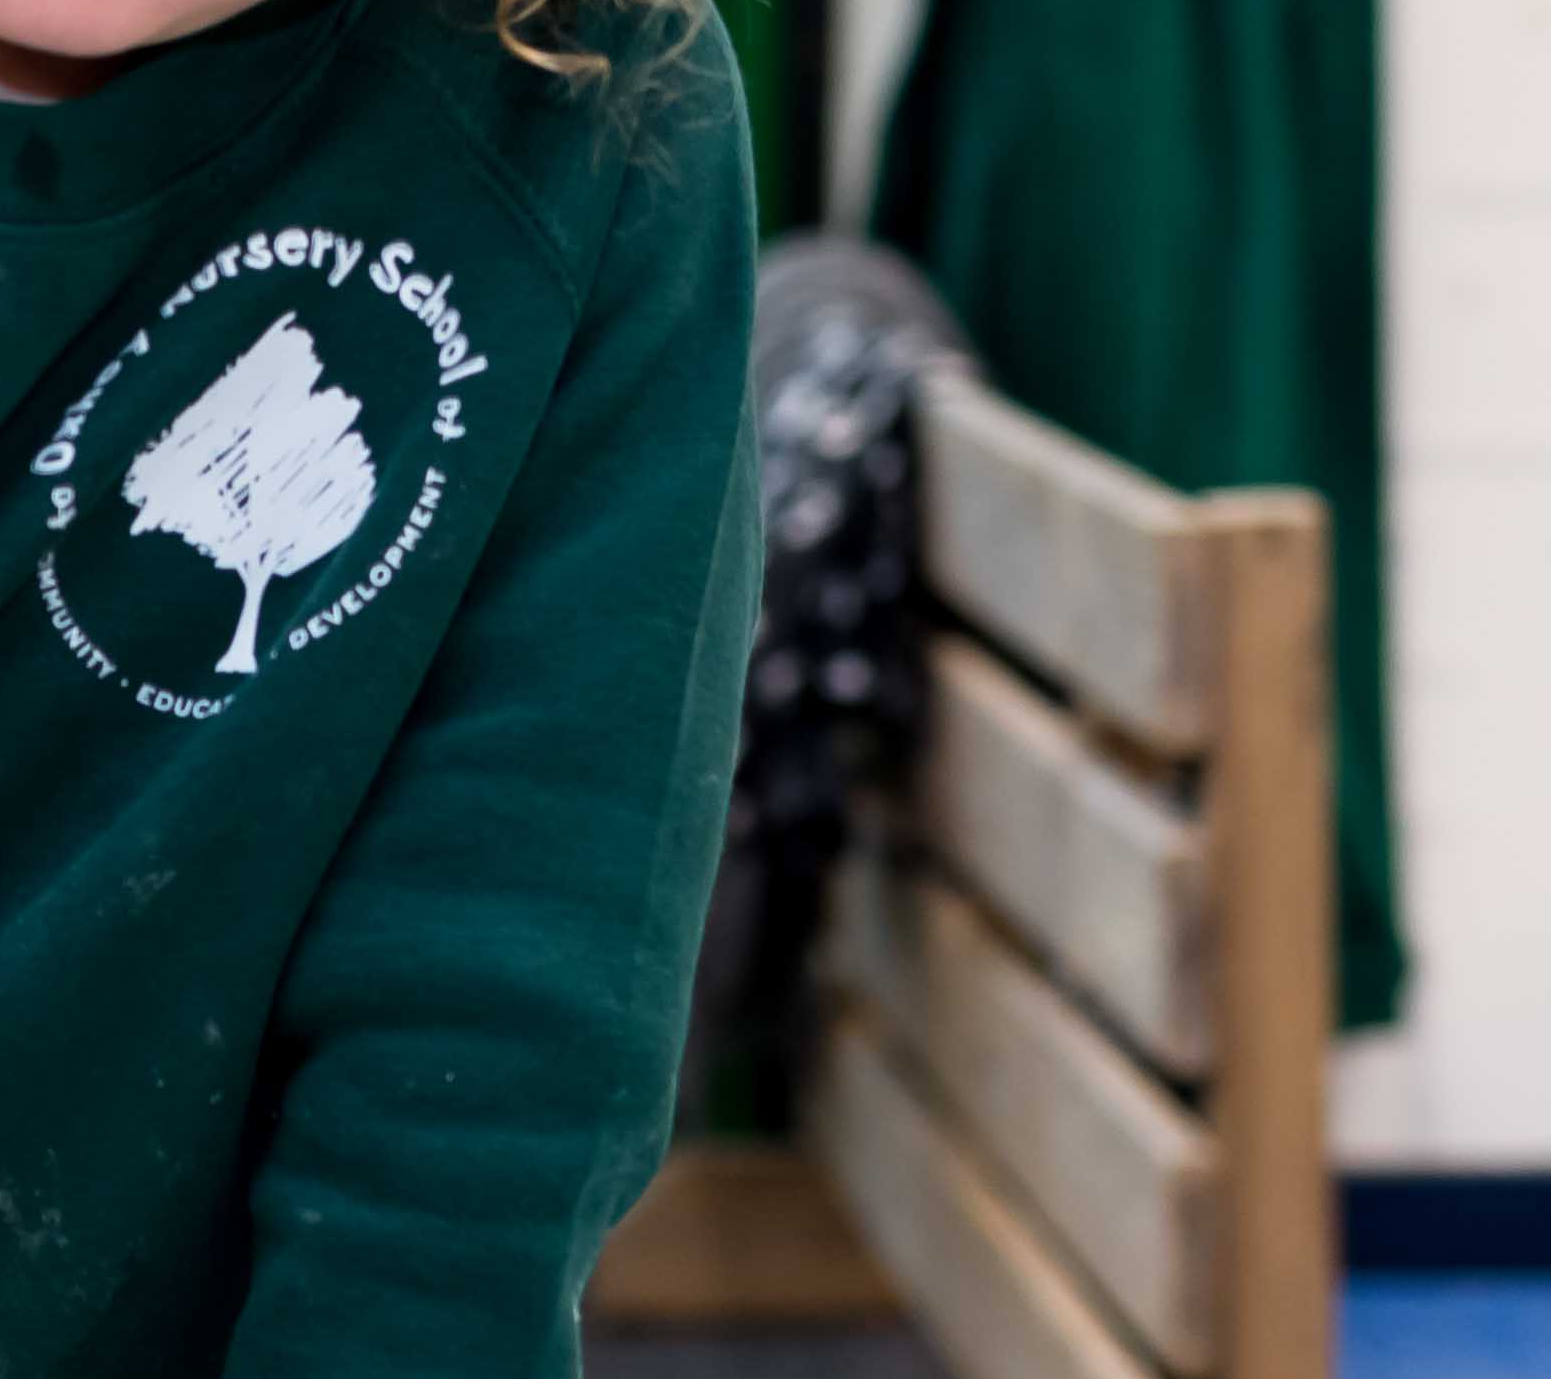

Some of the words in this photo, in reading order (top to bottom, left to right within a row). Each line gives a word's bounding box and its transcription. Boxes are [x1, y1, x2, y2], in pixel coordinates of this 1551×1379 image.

[369, 240, 489, 387] School
[36, 549, 118, 680] MMUNITY
[135, 681, 237, 720] EDUCA
[288, 466, 448, 651] DEVELOPMENT
